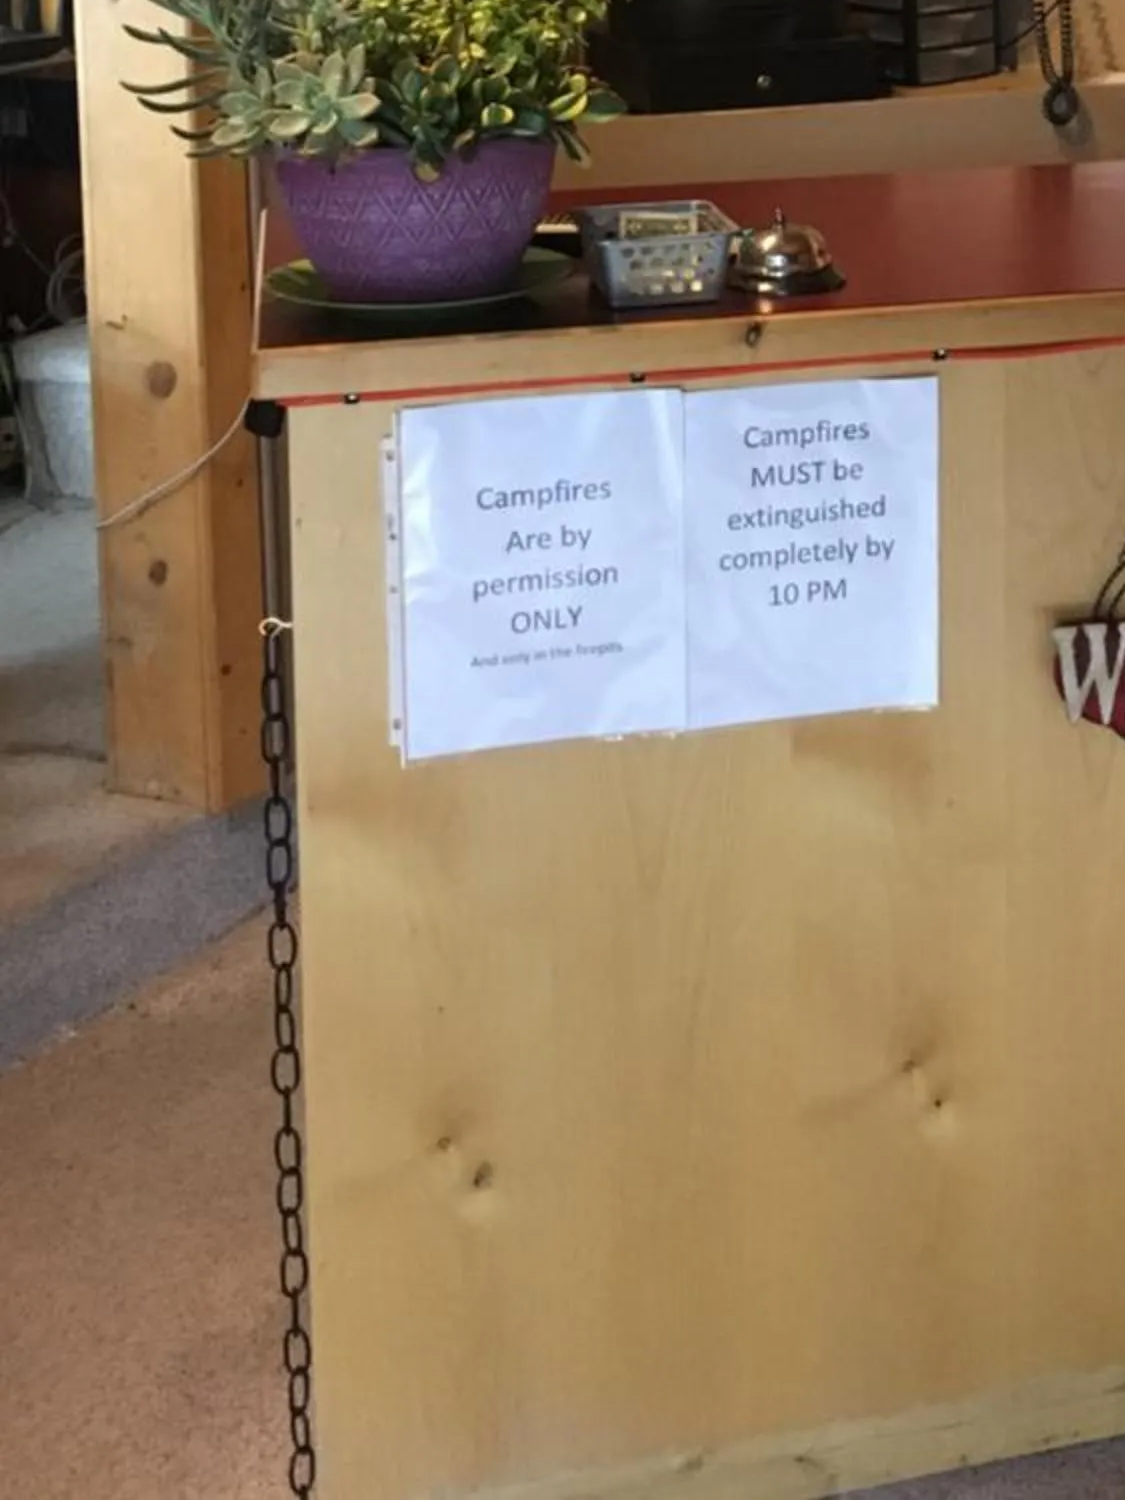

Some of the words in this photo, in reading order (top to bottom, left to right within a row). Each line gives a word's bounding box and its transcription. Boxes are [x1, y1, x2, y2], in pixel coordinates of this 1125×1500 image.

[743, 419, 871, 450] Campfires
[750, 460, 826, 489] MUST
[833, 458, 865, 482] be
[475, 478, 612, 511] Campfires
[727, 495, 887, 532] extinguished
[504, 529, 553, 554] Are
[560, 524, 592, 551] by
[719, 536, 860, 573] completely
[865, 534, 896, 561] by
[471, 563, 620, 602] permission
[768, 581, 801, 608] 10
[806, 577, 849, 603] PM
[510, 605, 584, 635] ONLY
[470, 653, 499, 668] And
[502, 652, 531, 666] only
[550, 647, 573, 660] the
